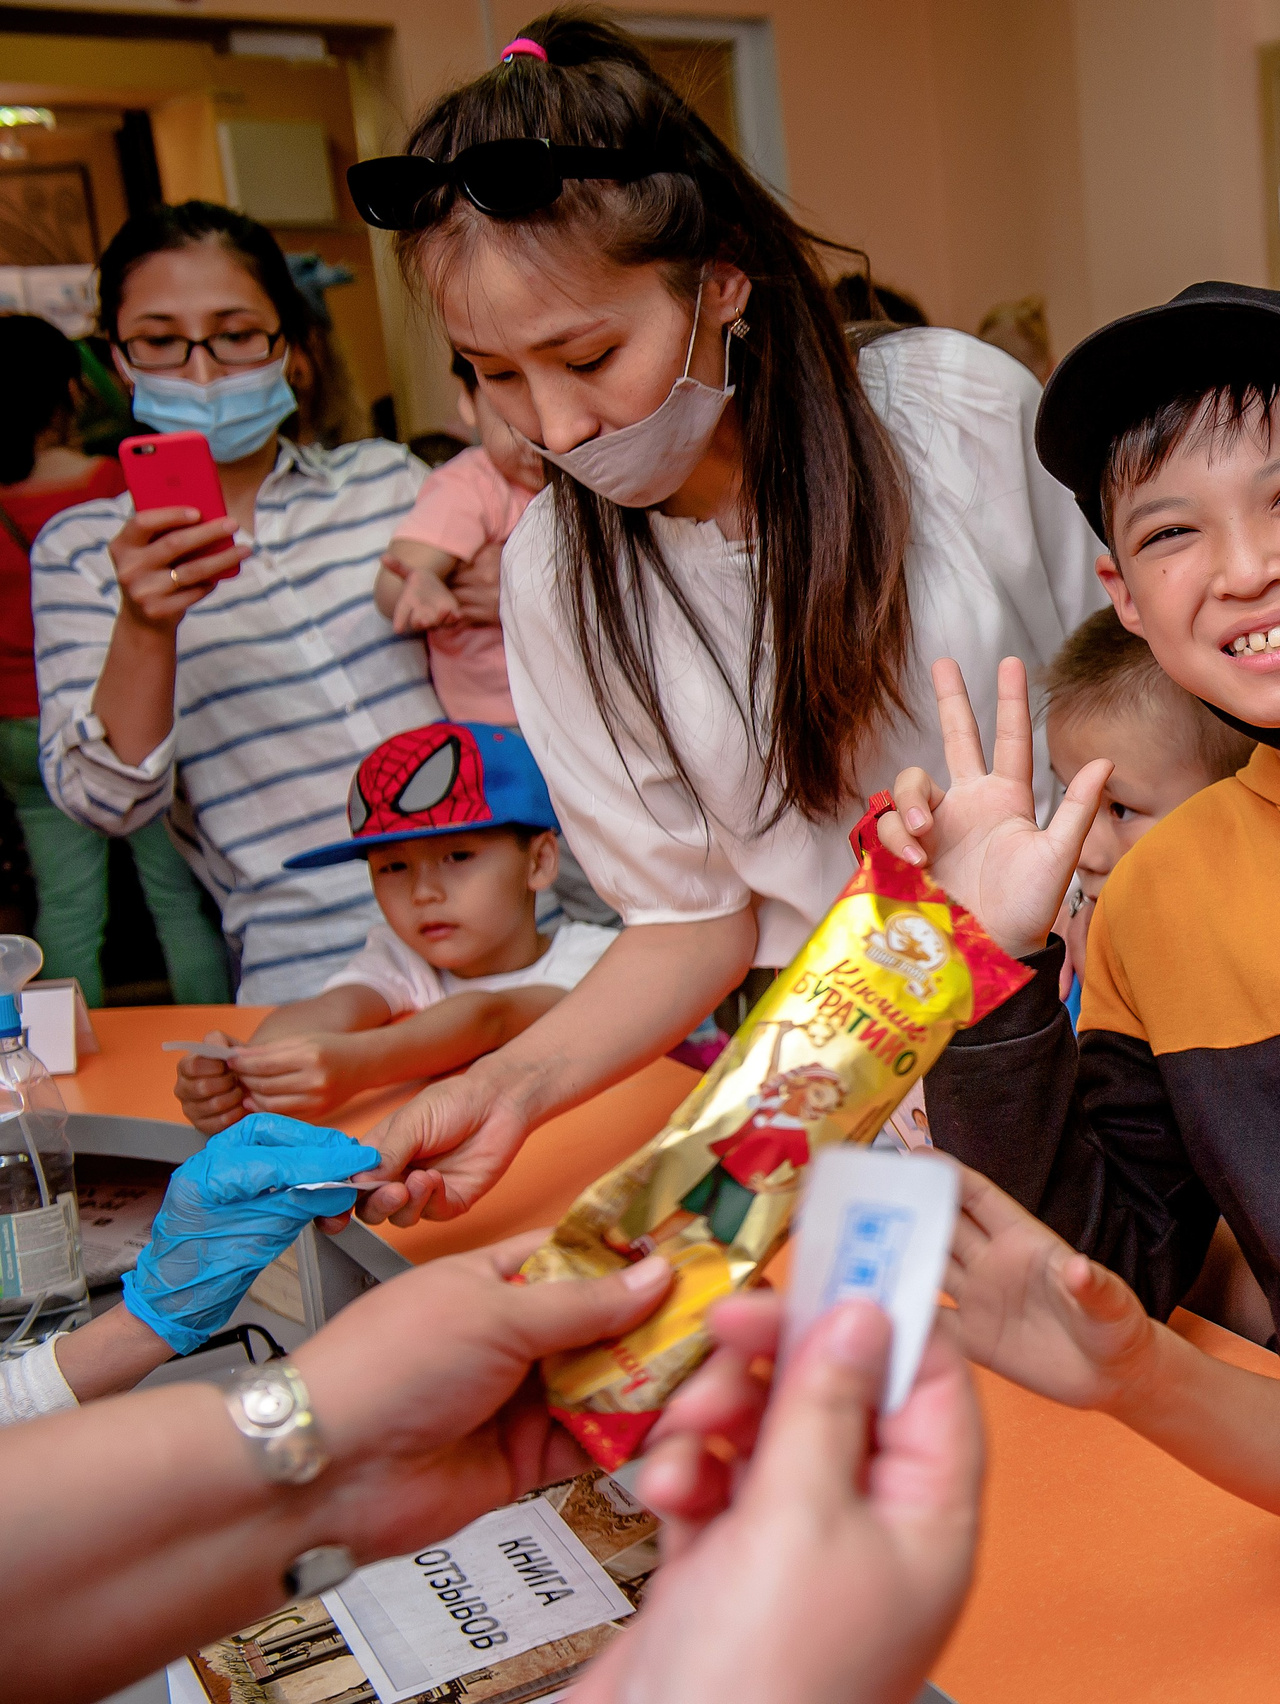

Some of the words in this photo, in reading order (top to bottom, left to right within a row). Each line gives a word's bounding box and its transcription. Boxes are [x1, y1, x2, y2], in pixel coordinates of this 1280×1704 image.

[793, 971, 917, 1077] БУРАТИНО
[414, 1549, 509, 1650] ОТЗЫВОВ
[498, 1536, 575, 1606] КНИГА
